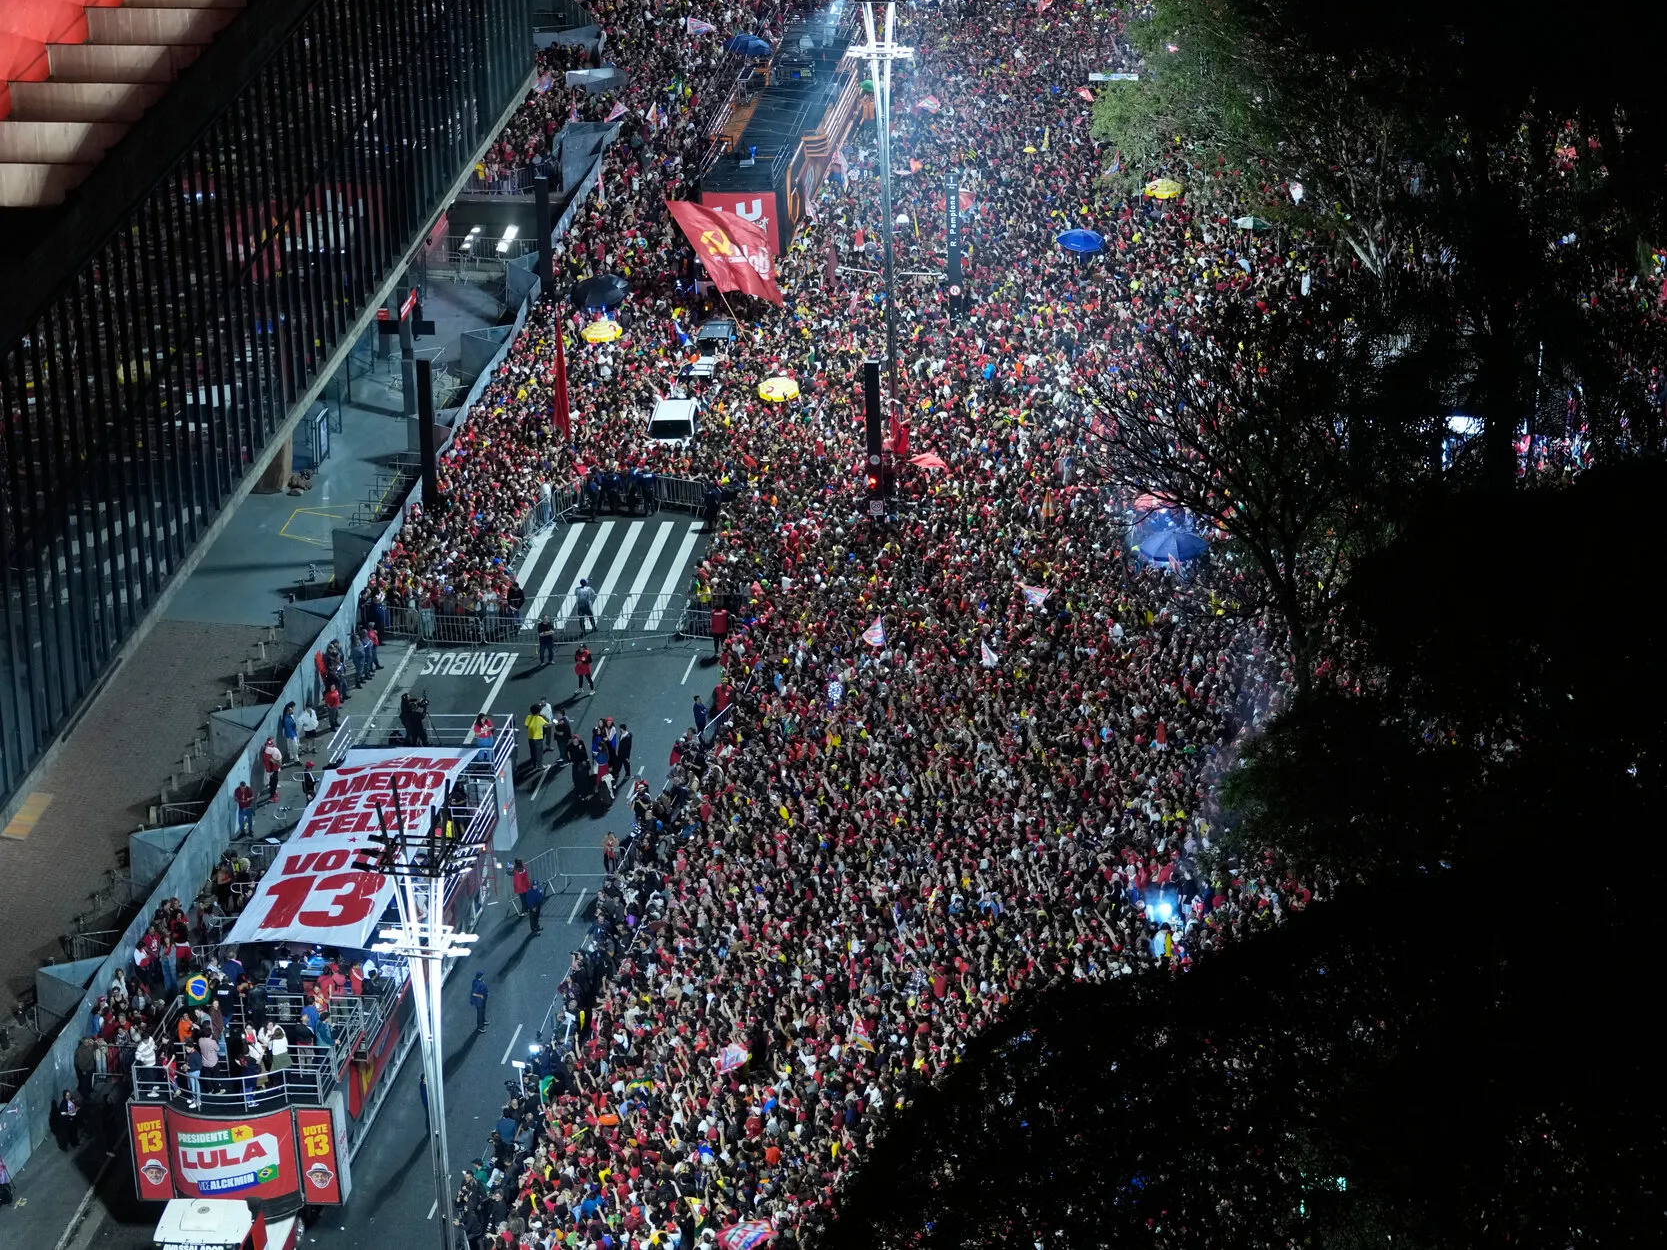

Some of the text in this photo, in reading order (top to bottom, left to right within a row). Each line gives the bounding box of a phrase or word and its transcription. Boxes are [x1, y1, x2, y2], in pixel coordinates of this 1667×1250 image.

[950, 195, 958, 235] Pamplona
[324, 771, 446, 799] MEDO
[312, 792, 434, 817] DE SER
[300, 809, 427, 838] FELIZ
[258, 872, 386, 929] 13
[136, 1119, 162, 1132] VOTE
[177, 1130, 229, 1144] PRESIDENTE
[303, 1123, 328, 1136] VOTE
[138, 1130, 163, 1154] 13
[304, 1134, 330, 1157] 13
[181, 1140, 268, 1169] LULA
[210, 1173, 255, 1190] ALCKMIN
